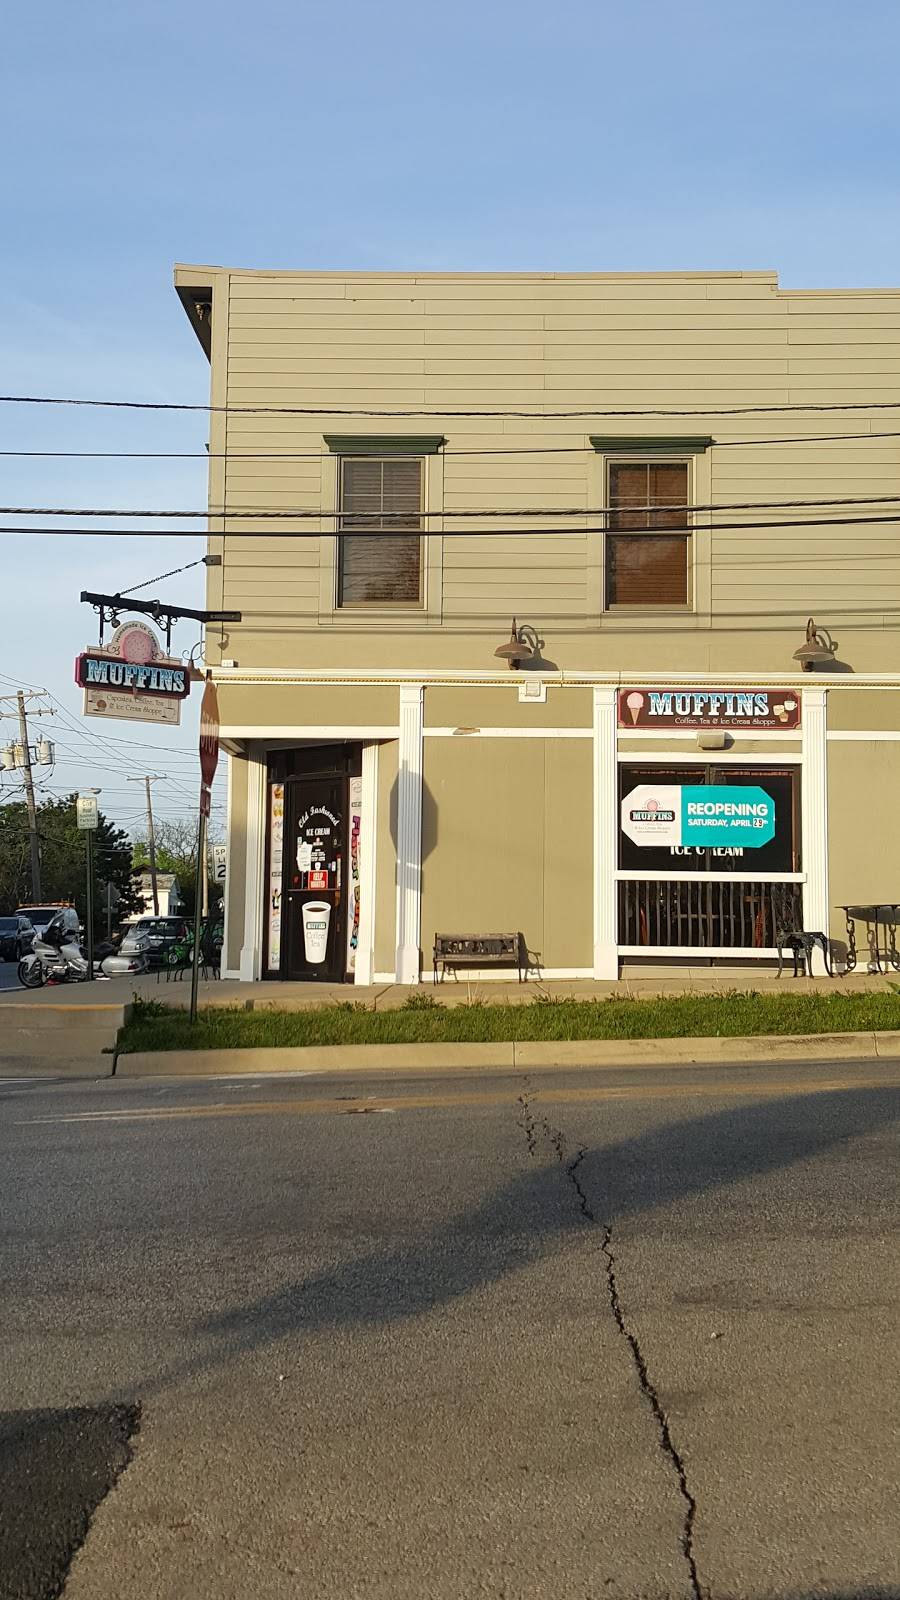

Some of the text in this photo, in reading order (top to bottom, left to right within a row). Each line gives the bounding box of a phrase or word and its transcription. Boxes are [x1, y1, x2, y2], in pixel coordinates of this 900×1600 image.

[86, 659, 185, 692] MUFFINS
[648, 692, 769, 716] MUFFINS
[699, 717, 710, 725] Tea
[720, 717, 730, 725] Ice
[731, 717, 750, 725] Cream
[752, 717, 776, 727] Shoppe
[687, 802, 768, 816] REOPENING
[298, 805, 340, 829] Old Fashioned
[632, 811, 673, 821] MUFFINS
[687, 818, 729, 828] SATURDAY,
[730, 819, 752, 827] APRIL
[306, 827, 331, 837] ICE CREAM
[670, 846, 693, 855] ICE
[217, 864, 226, 878] 2
